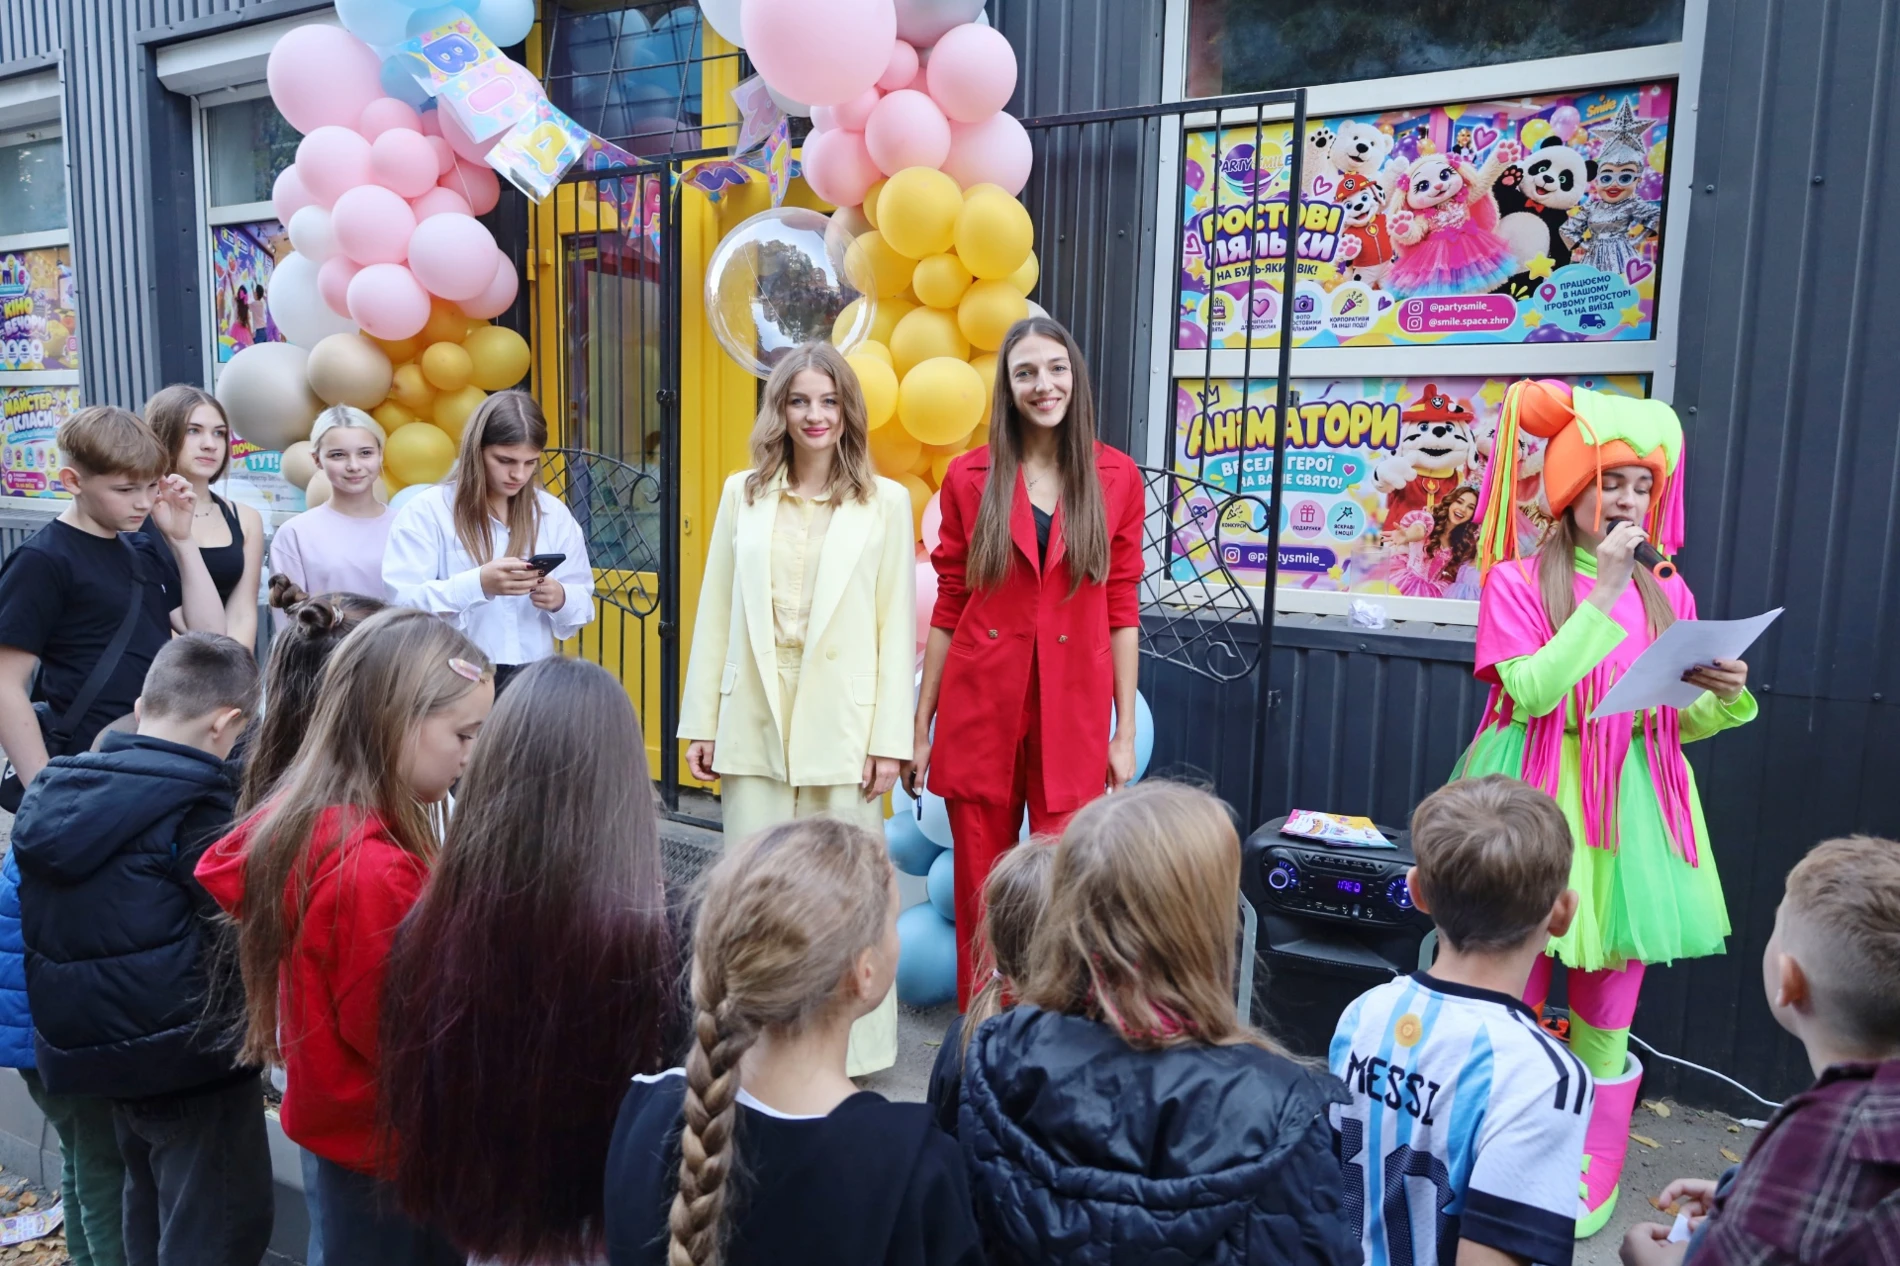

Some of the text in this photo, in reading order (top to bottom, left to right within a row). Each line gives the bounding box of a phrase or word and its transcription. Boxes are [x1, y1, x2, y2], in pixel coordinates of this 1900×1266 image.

[1253, 154, 1293, 170] MILE
[1216, 262, 1318, 282] НА БУЬ-ЯКИ ВІК!
[1560, 274, 1611, 291] ПРАЦЮЄМО
[1563, 284, 1609, 299] В НАШОМУ
[4, 297, 33, 320] КІНО
[1429, 302, 1493, 313] @partysmile_
[1544, 289, 1631, 312] ІГРОВОМУ ПРОСТОРІ
[1563, 301, 1614, 317] ТА НА ВИЇЗД
[4, 314, 46, 336] ВЕЧОРИ
[1428, 316, 1509, 327] @smile.space.zhm
[13, 410, 53, 433] КЛАСИ
[249, 453, 280, 470] ТУТ!
[1221, 454, 1336, 477] ВЕСЕЛ ГЕРОЇ
[1257, 474, 1293, 486] ВАЕ
[1296, 473, 1343, 489] СВЯТО!
[1248, 552, 1326, 567] @patysmile_
[1345, 1050, 1441, 1127] MESSI
